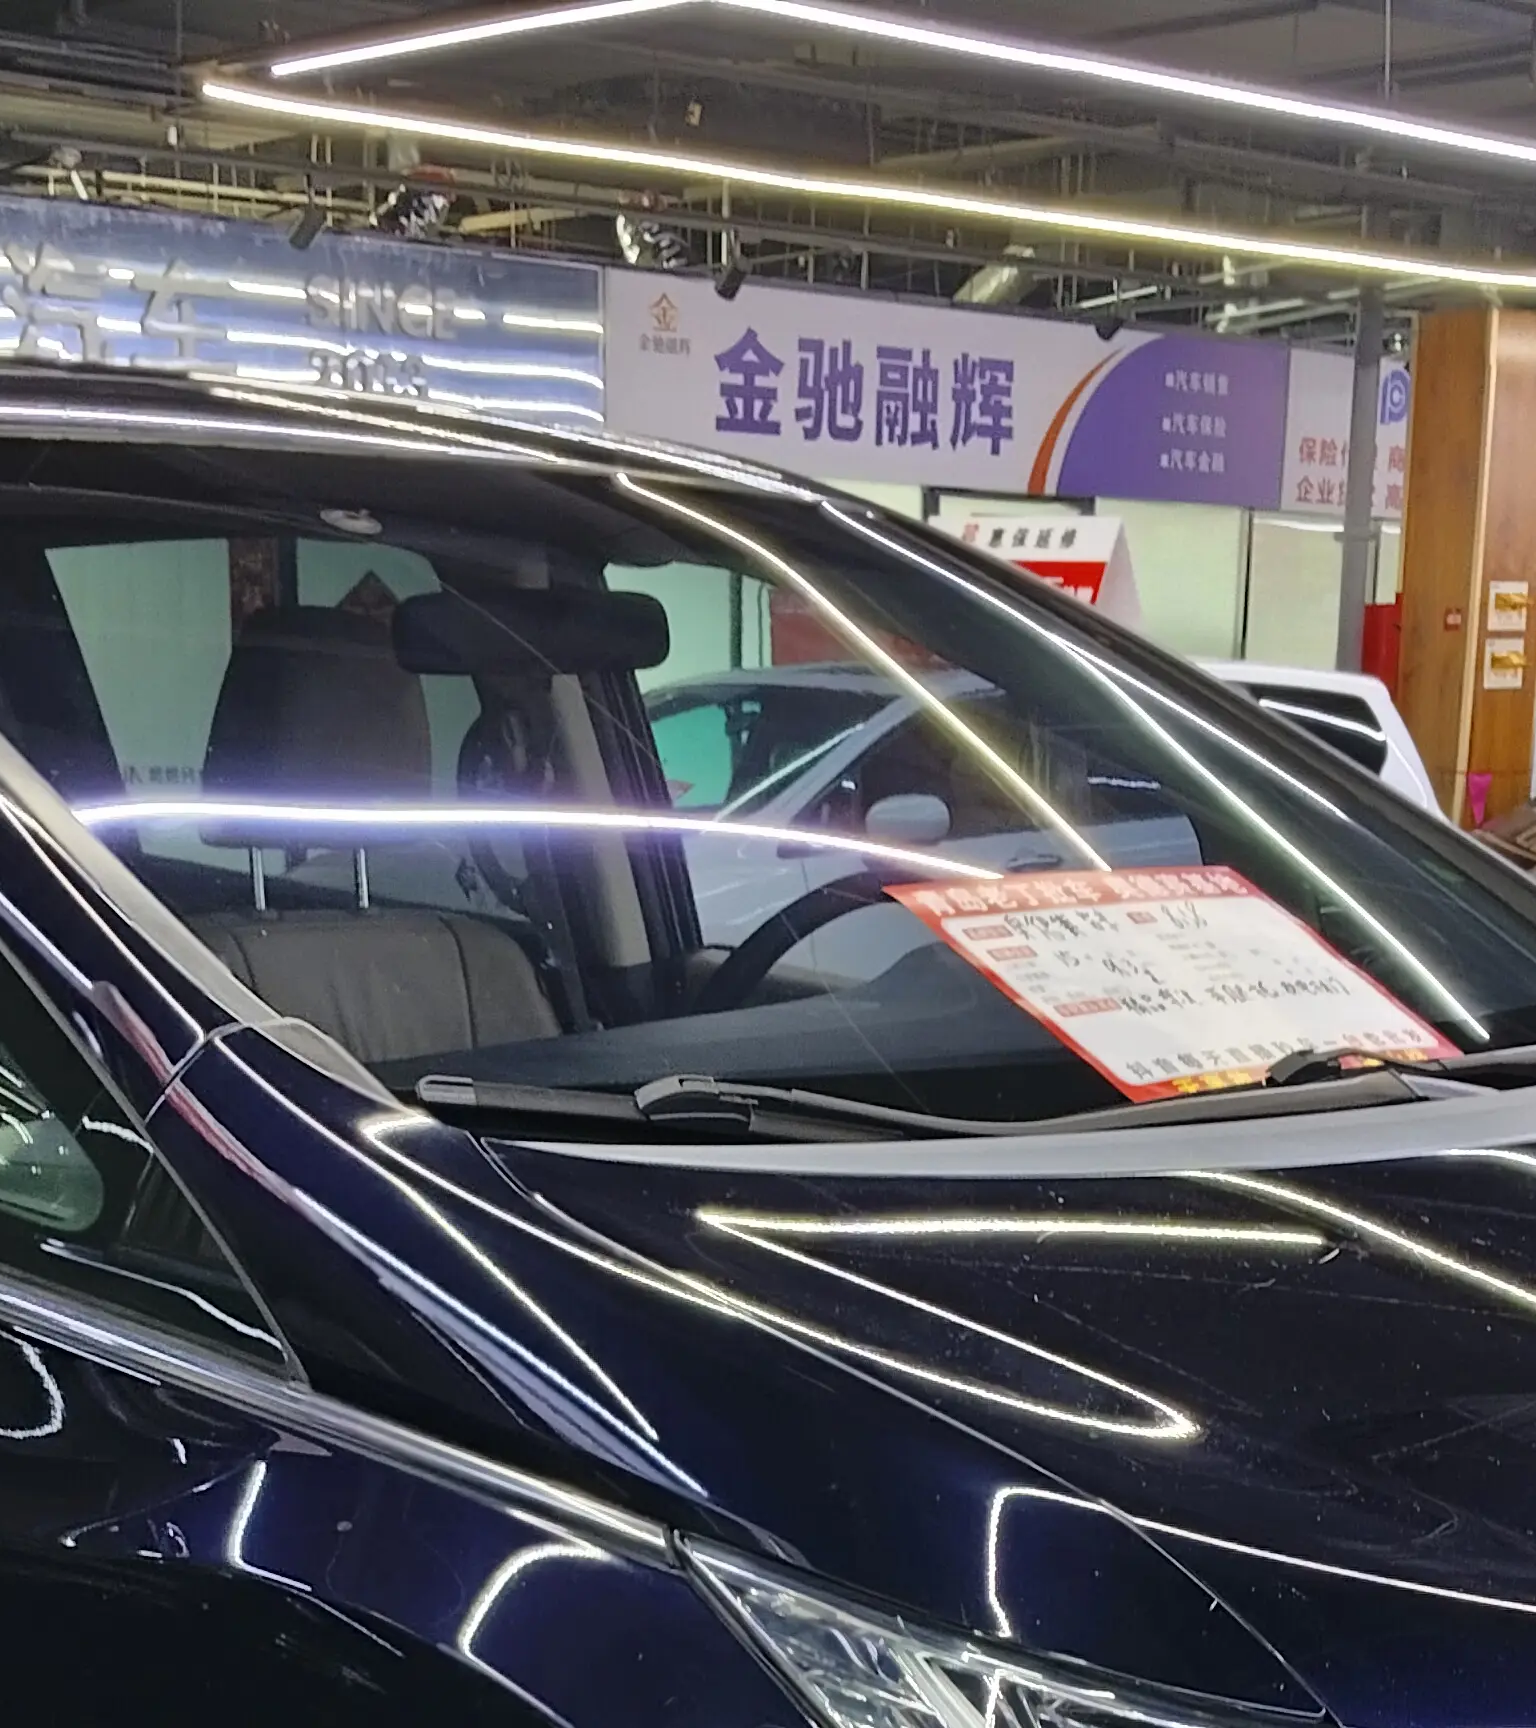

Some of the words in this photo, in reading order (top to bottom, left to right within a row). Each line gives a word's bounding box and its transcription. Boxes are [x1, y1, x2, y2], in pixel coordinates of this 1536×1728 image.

[305, 273, 459, 340] SINCE
[714, 327, 1016, 457] 金驰融辉
